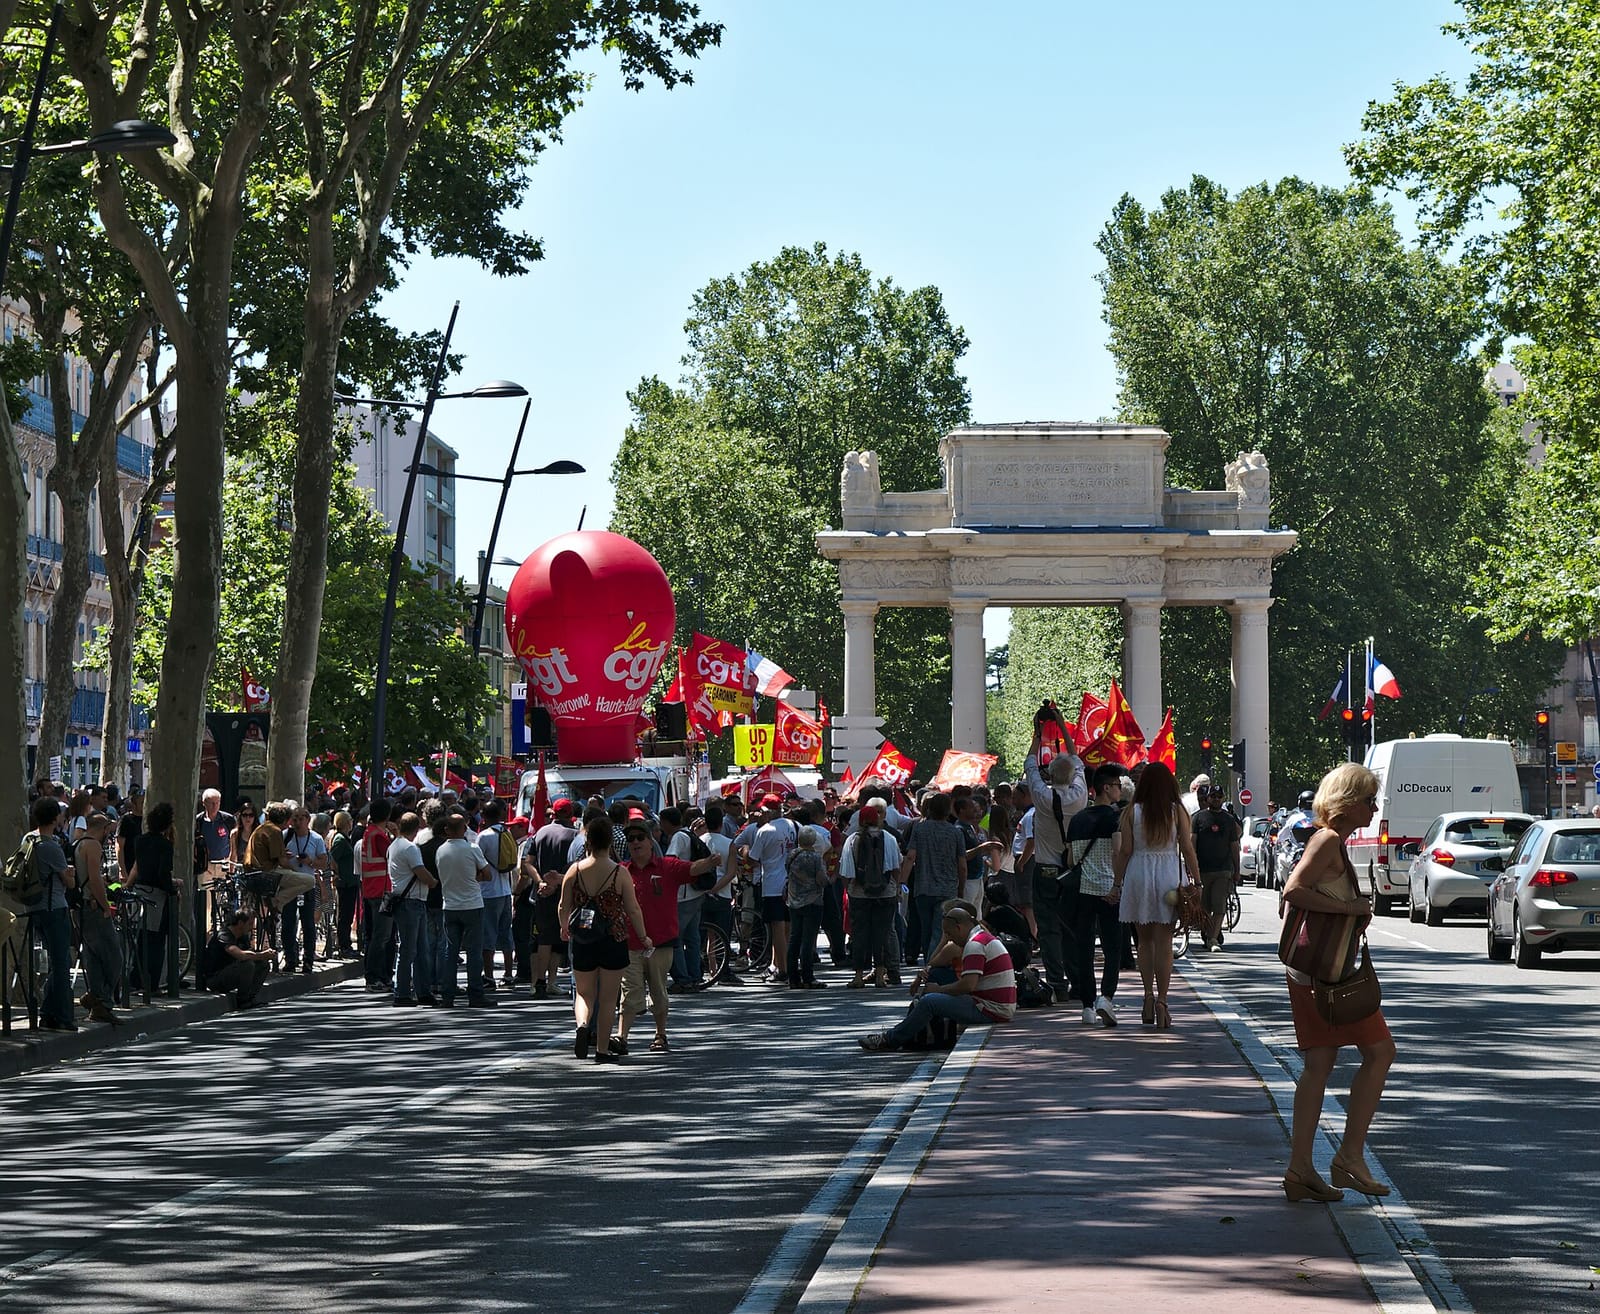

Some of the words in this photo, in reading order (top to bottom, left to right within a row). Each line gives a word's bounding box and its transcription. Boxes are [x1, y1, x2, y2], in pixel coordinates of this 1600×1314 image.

[1024, 463, 1121, 474] COMBATTANTS
[517, 629, 564, 657] la
[613, 622, 667, 651] la
[699, 641, 735, 665] la
[519, 647, 578, 696] cgt
[603, 641, 667, 691] cgt
[697, 653, 740, 685] cgt
[246, 683, 270, 705] cg
[749, 728, 768, 746] UD
[791, 729, 819, 750] cgt
[750, 747, 765, 762] 31
[876, 757, 911, 786] cgt
[1397, 783, 1452, 793] JCDecaux
